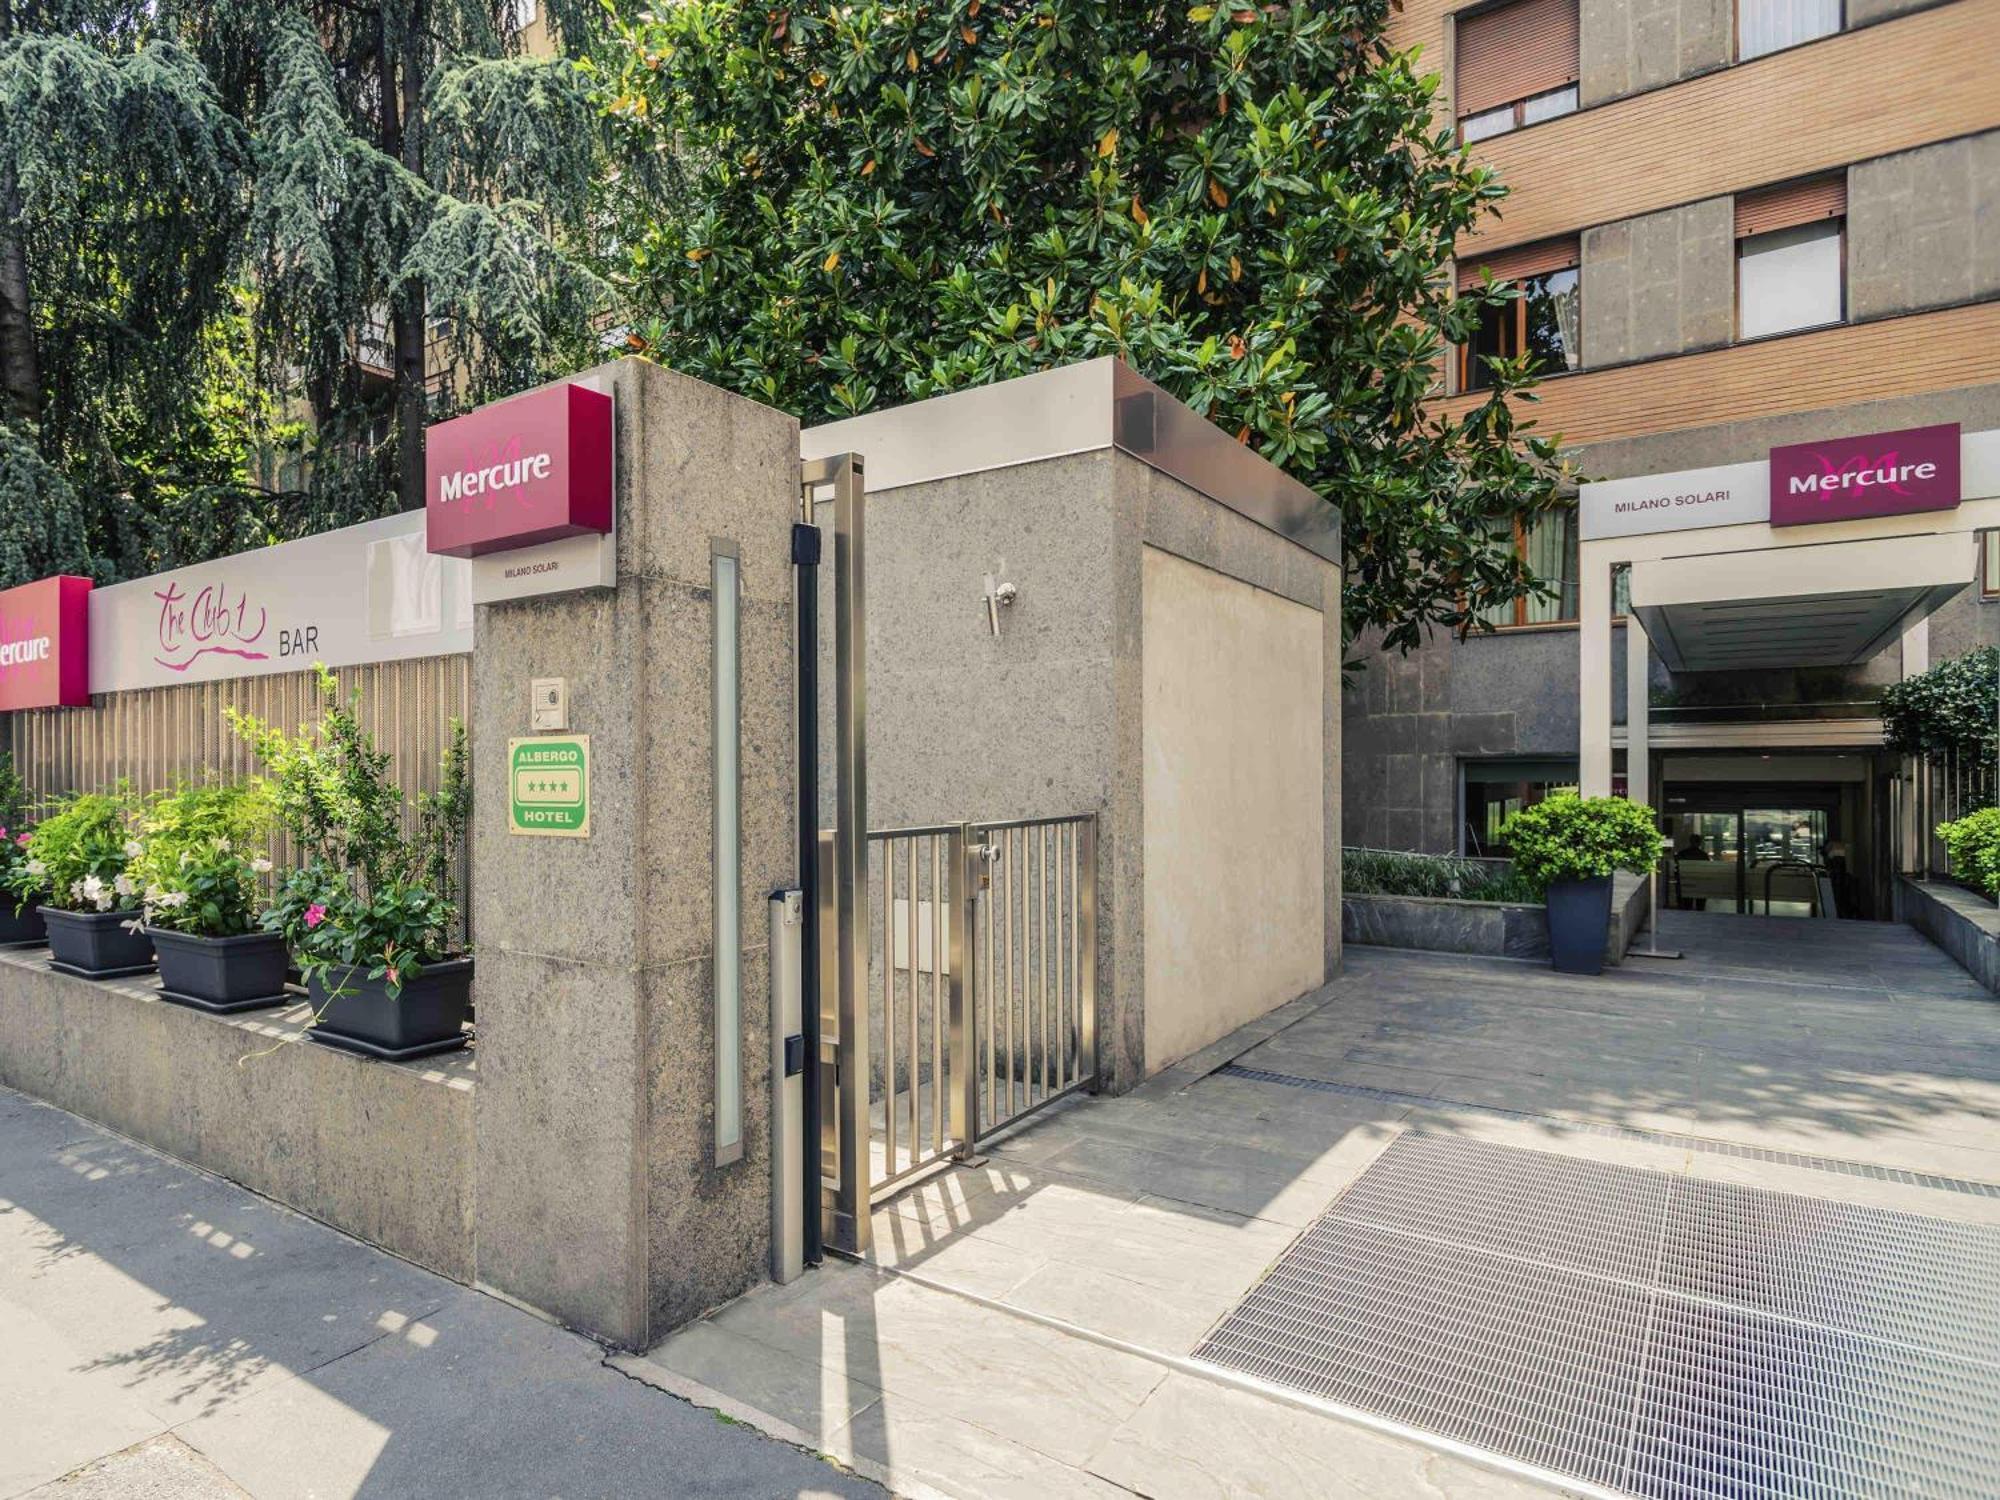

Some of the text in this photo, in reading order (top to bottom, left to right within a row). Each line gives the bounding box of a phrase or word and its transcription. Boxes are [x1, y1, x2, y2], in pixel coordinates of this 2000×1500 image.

[439, 452, 551, 502] Mercure
[1789, 461, 1937, 495] Mercure
[1614, 490, 1730, 513] MILANO SOLARI
[504, 561, 560, 578] MILANO SOLARI
[191, 581, 231, 642] Club
[0, 636, 50, 667] ercure
[279, 625, 319, 657] BAR
[518, 751, 578, 763] ALBERGO
[523, 811, 574, 823] HOTEL
